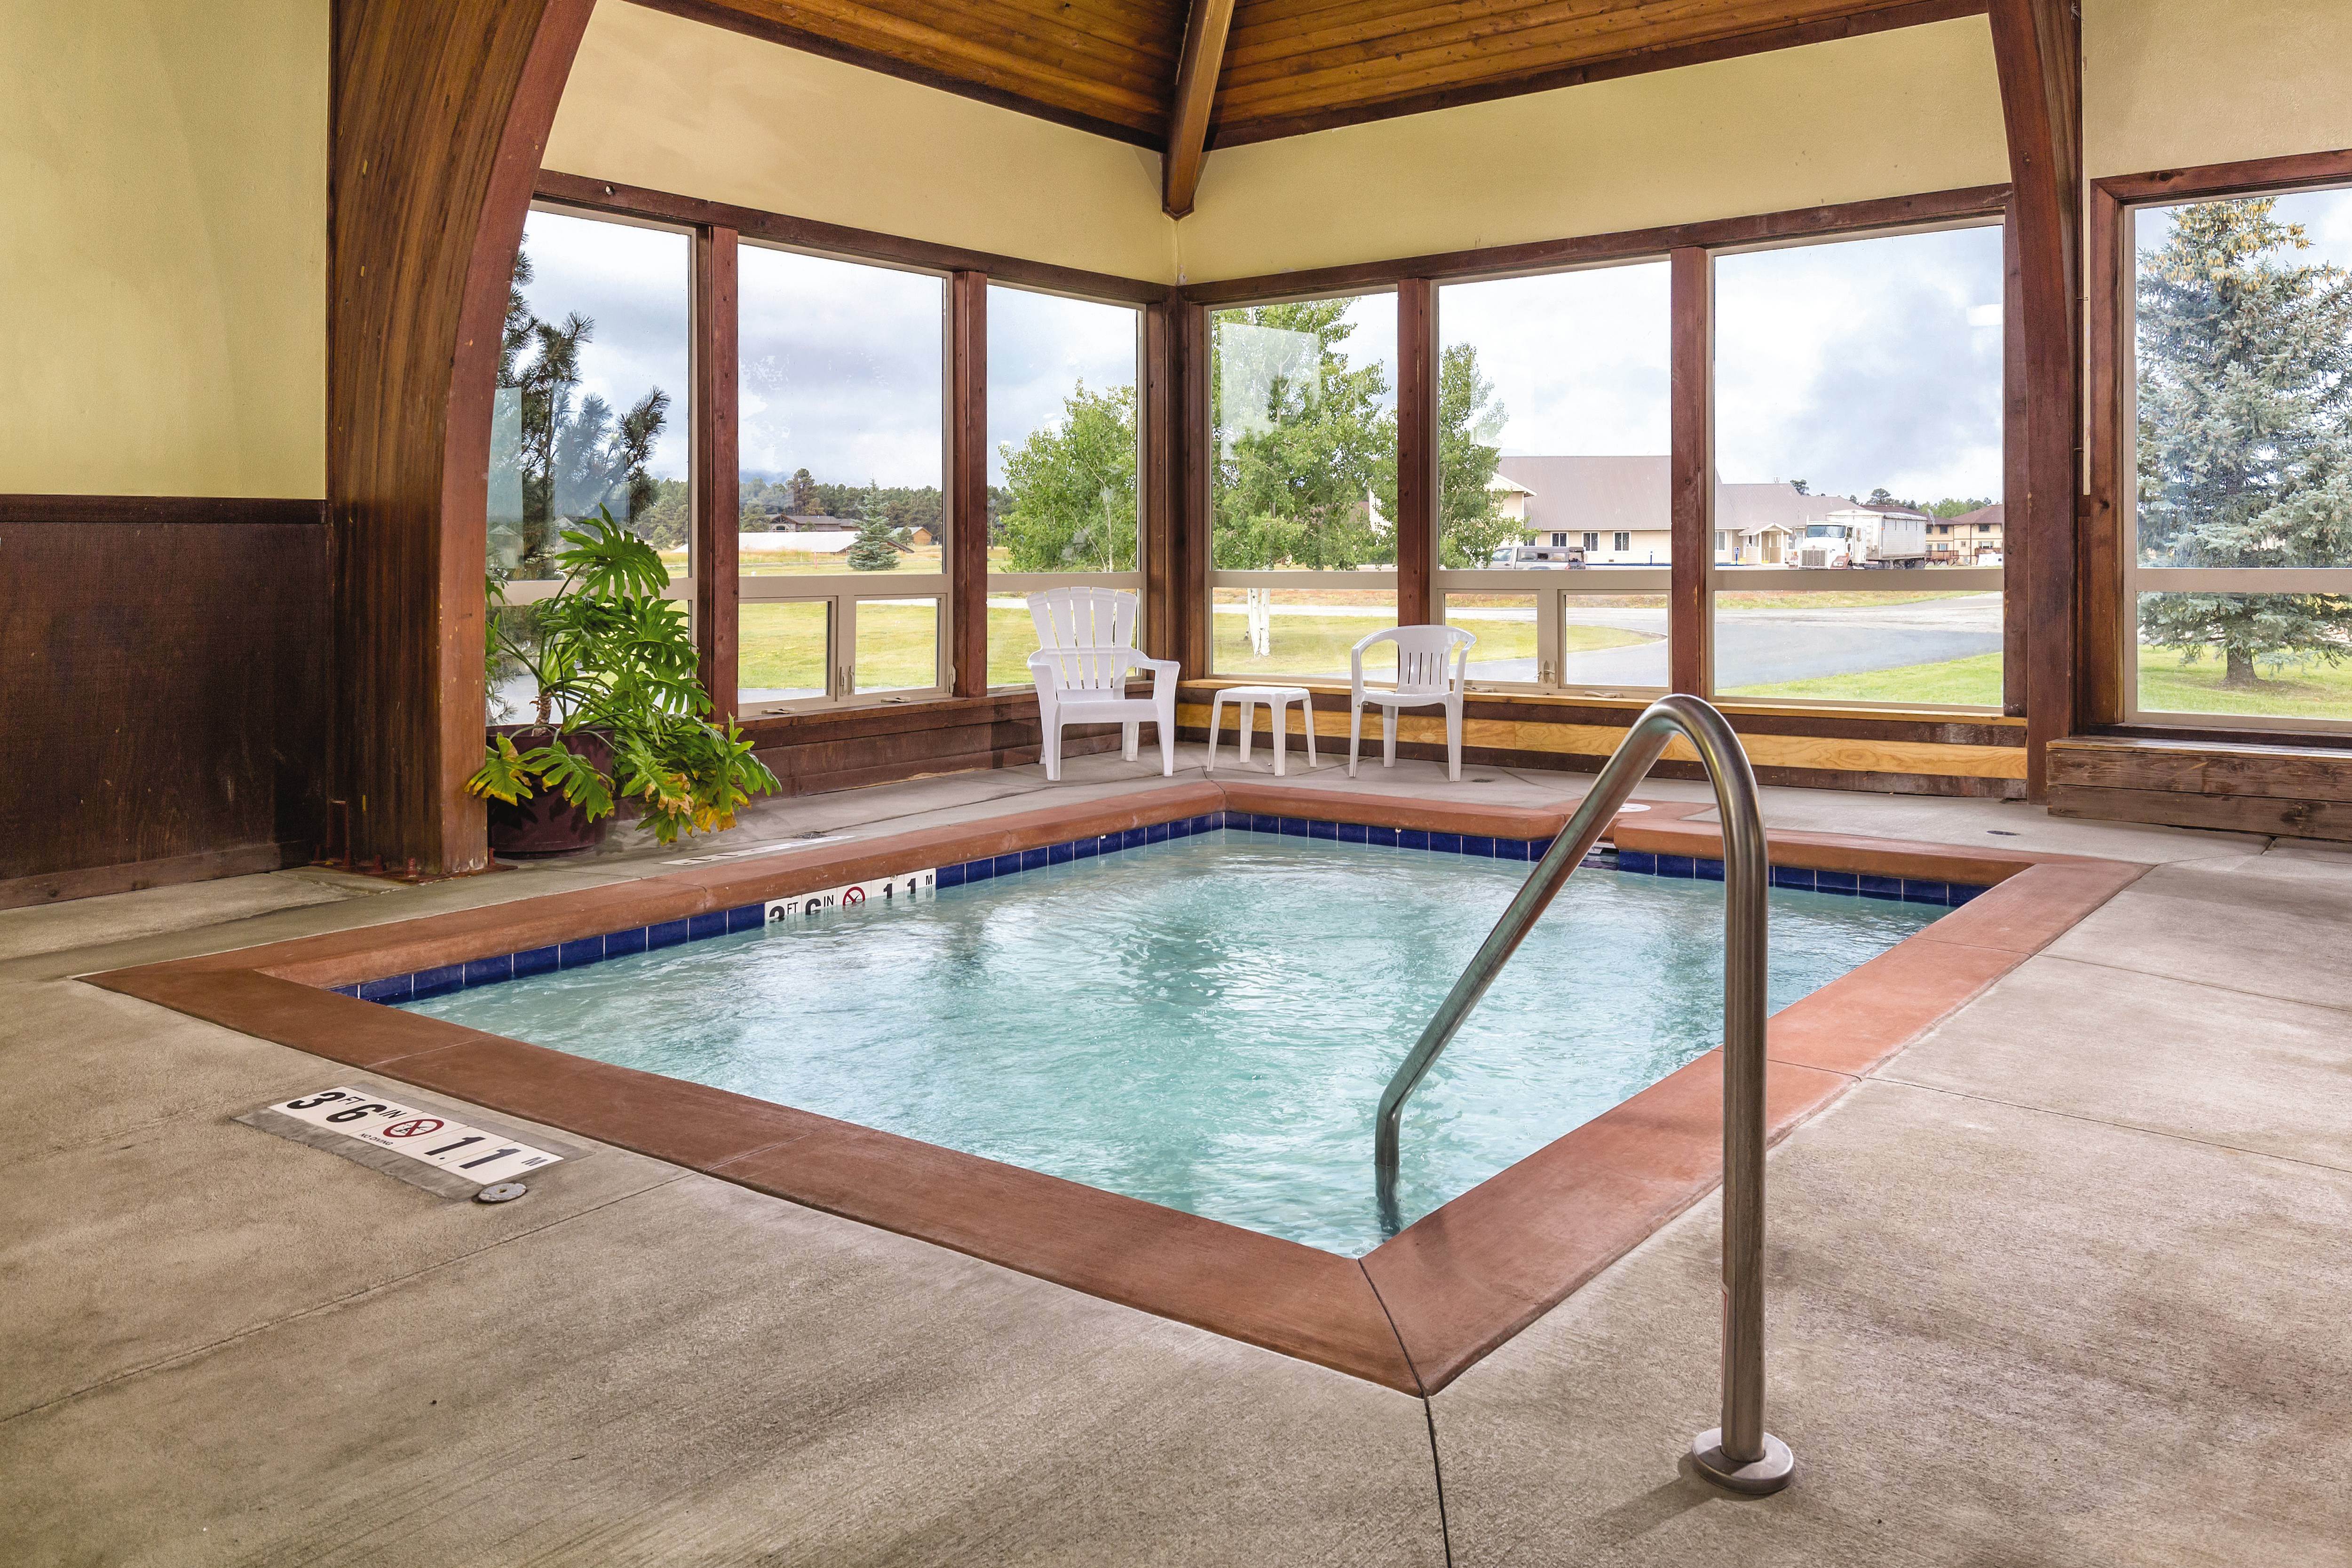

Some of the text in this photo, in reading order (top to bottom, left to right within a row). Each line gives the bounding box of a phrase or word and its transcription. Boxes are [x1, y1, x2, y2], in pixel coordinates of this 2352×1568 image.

[926, 874, 933, 886] M
[787, 902, 799, 915] FT
[824, 895, 835, 907] IN
[286, 1092, 407, 1123] 3 FT 6 IN
[369, 1136, 394, 1146] DIVING
[521, 1156, 548, 1166] M
